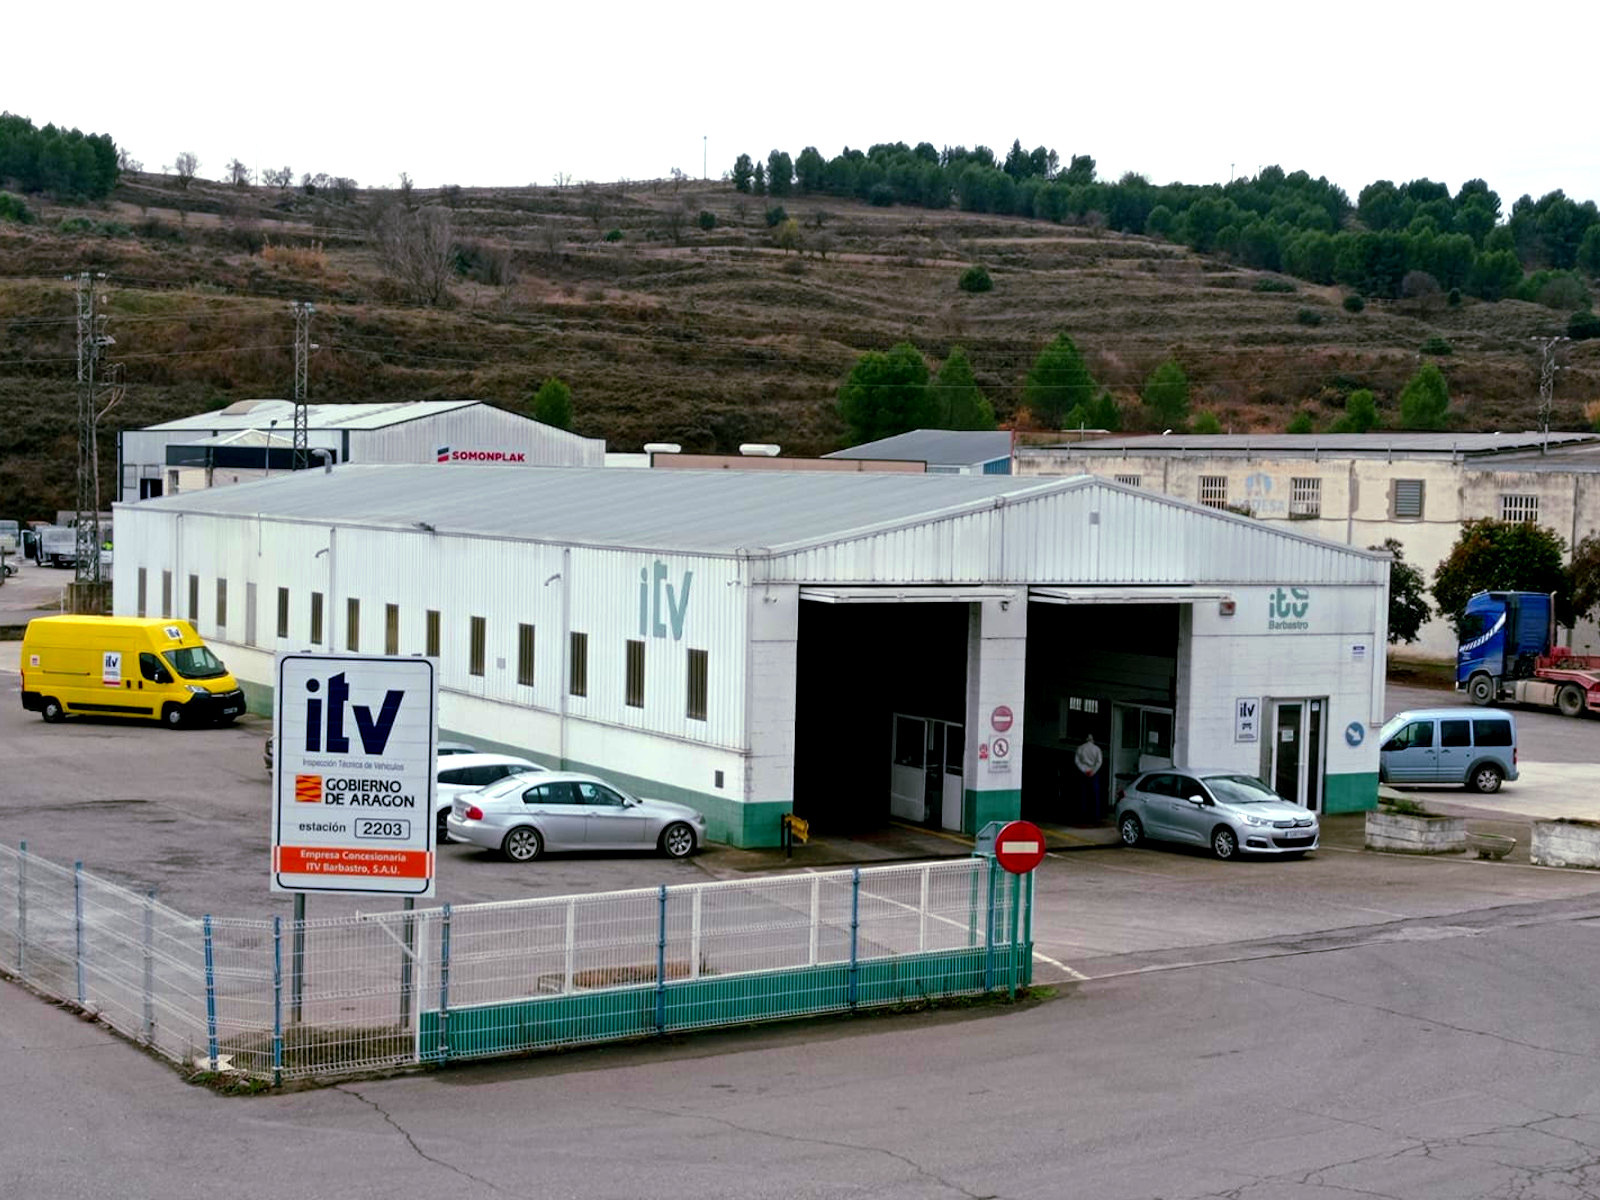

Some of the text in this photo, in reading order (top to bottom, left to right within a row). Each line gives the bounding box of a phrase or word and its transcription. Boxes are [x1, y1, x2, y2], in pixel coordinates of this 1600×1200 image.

[452, 451, 526, 462] SOMONPLAK
[1268, 620, 1309, 630] Barbastro
[305, 672, 406, 755] itv
[1240, 702, 1255, 717] itv
[302, 758, 337, 768] Inspección
[325, 778, 402, 793] GOBIERNO
[325, 792, 415, 808] DE ARAGON
[299, 822, 402, 836] estación 2203
[300, 849, 340, 860] Empresa
[306, 862, 400, 874] ITV Barbastro, S.A.U.
